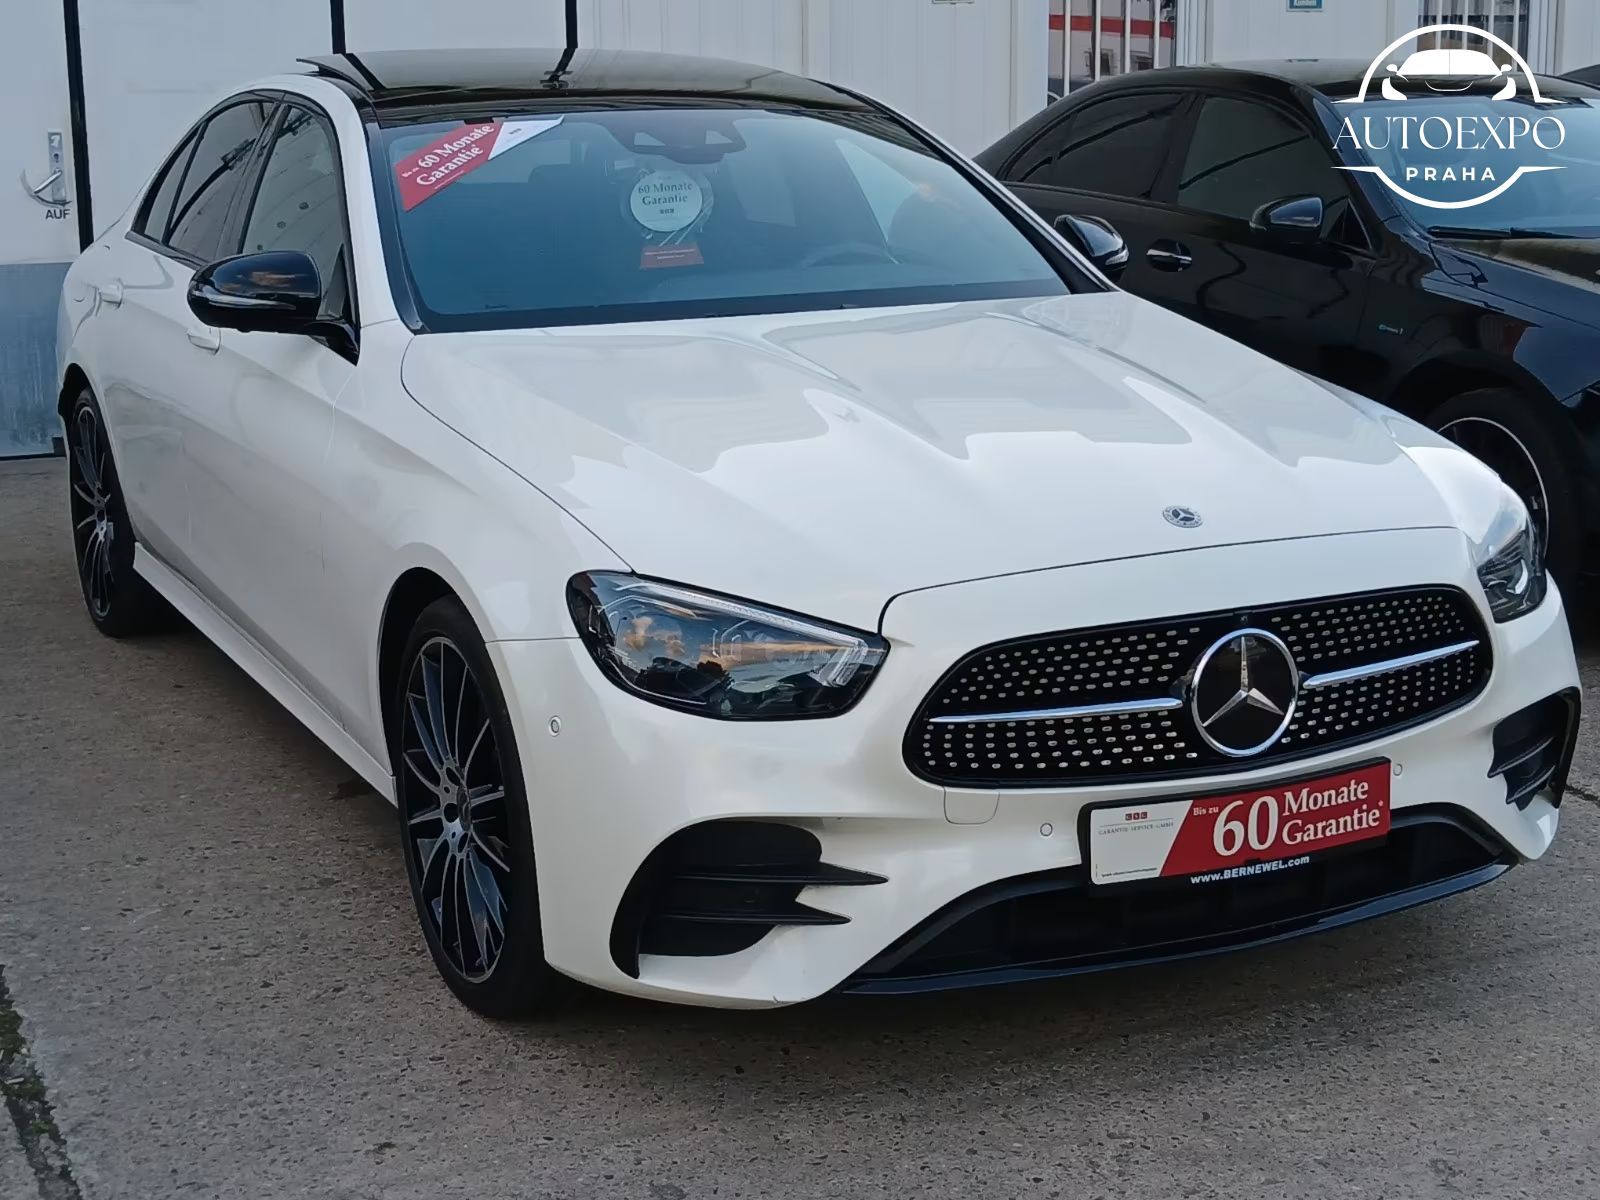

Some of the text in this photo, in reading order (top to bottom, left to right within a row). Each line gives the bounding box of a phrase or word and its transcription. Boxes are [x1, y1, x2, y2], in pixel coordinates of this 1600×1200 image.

[418, 125, 495, 168] 60 Monate
[638, 181, 693, 194] 60 Monate
[642, 194, 688, 206] Garantie
[45, 208, 71, 220] AUF
[1282, 780, 1369, 817] Monate
[1193, 795, 1279, 857] Bis zu 60
[1190, 855, 1310, 884] www.BERNEWEL.com
